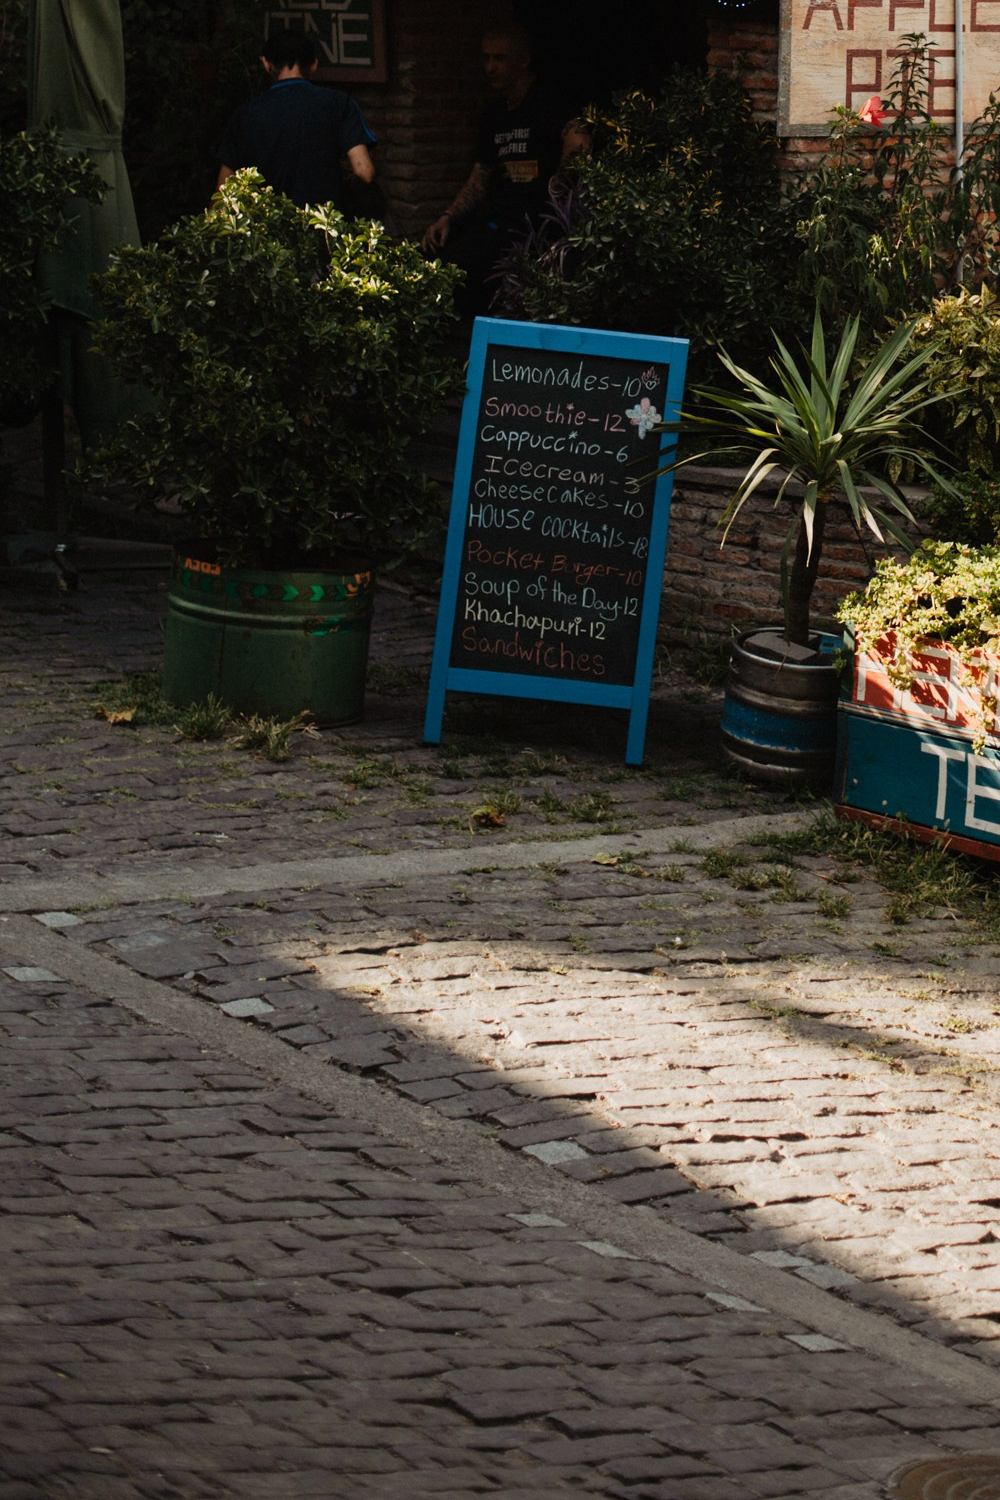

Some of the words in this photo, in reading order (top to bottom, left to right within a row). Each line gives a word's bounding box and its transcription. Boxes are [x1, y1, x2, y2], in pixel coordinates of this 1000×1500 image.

[845, 49, 957, 118] PIE
[464, 571, 520, 605] Soup
[527, 575, 547, 600] of
[552, 580, 577, 605] the
[462, 626, 606, 675] Sandwiches
